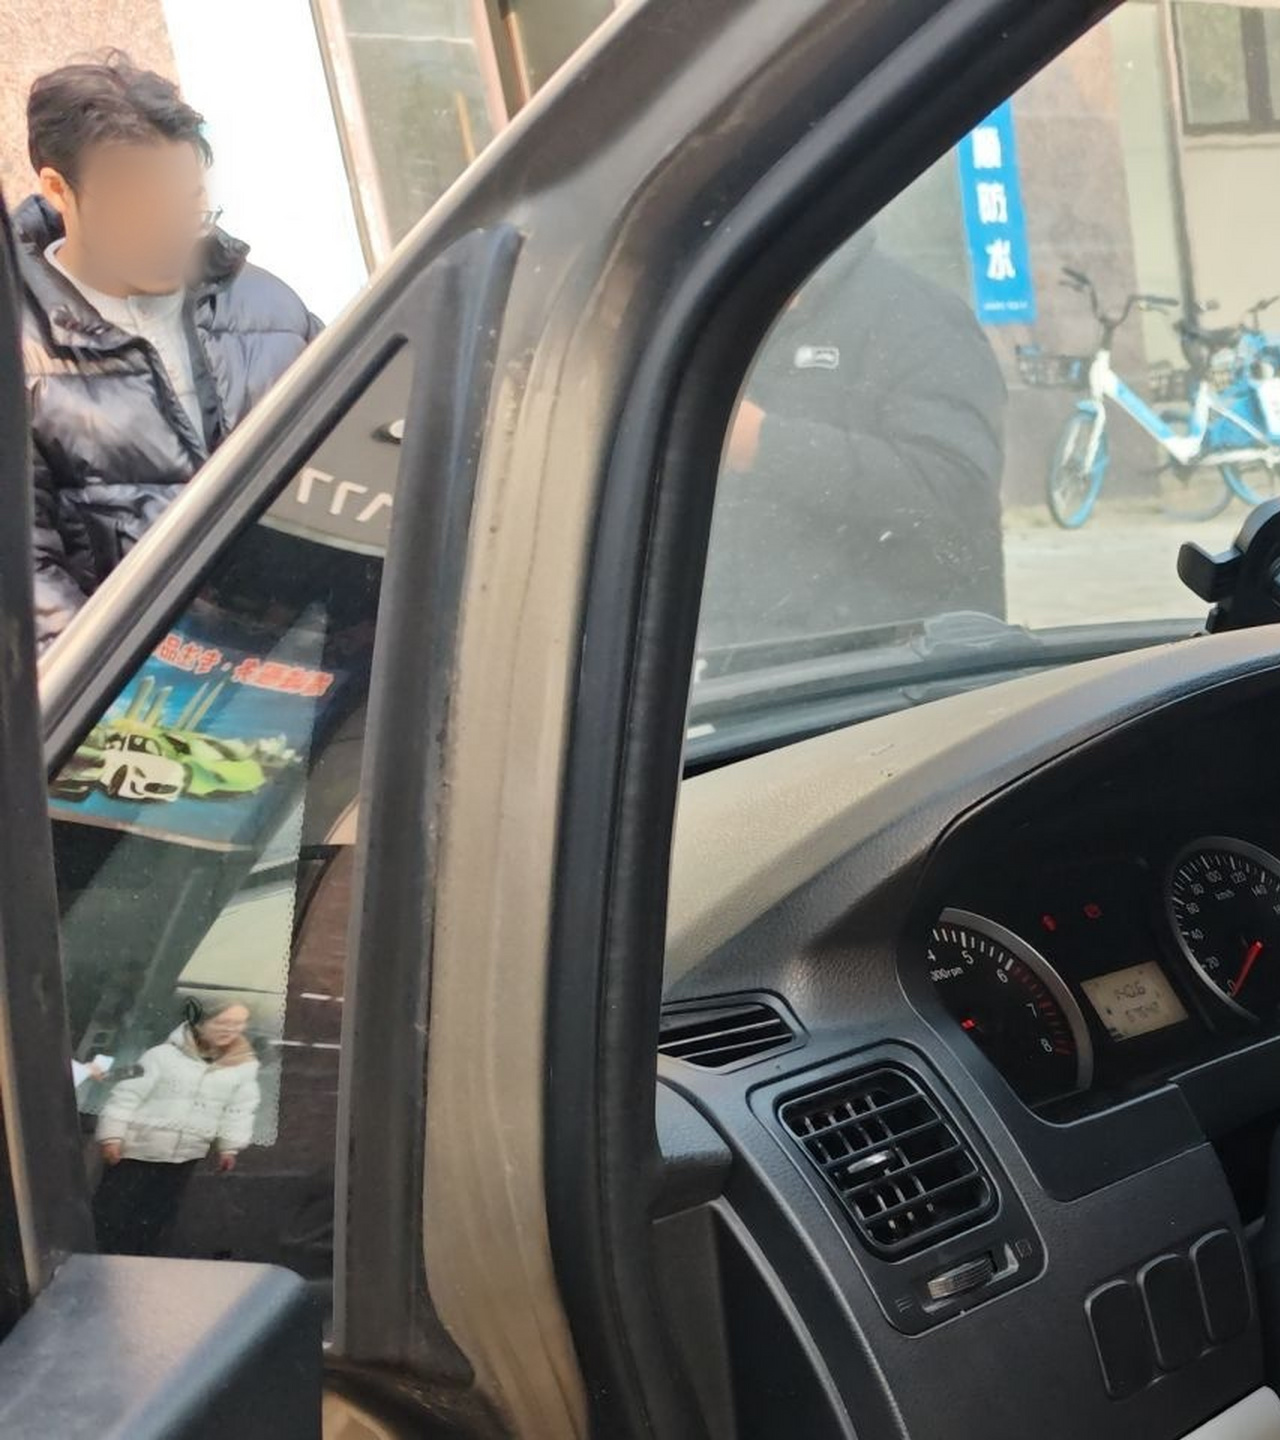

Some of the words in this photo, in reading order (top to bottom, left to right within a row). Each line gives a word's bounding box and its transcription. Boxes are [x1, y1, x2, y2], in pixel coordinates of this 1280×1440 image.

[961, 950, 974, 965] 5
[996, 968, 1008, 983] 6
[1026, 1003, 1038, 1018] 7
[1040, 1038, 1053, 1053] 8
